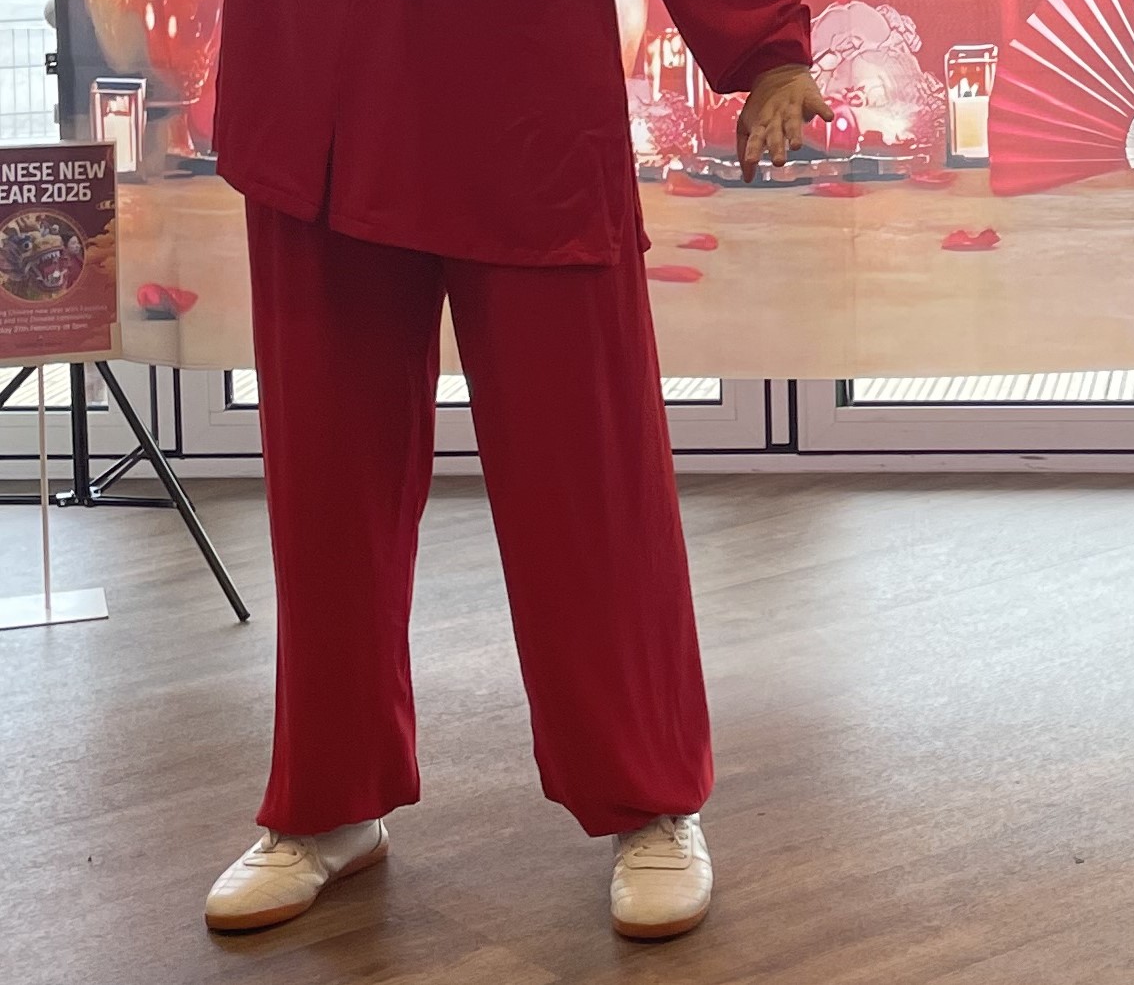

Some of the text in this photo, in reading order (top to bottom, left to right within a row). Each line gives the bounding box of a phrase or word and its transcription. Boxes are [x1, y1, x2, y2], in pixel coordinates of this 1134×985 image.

[1, 160, 106, 182] NESE NEW
[0, 182, 92, 204] EAR 2026
